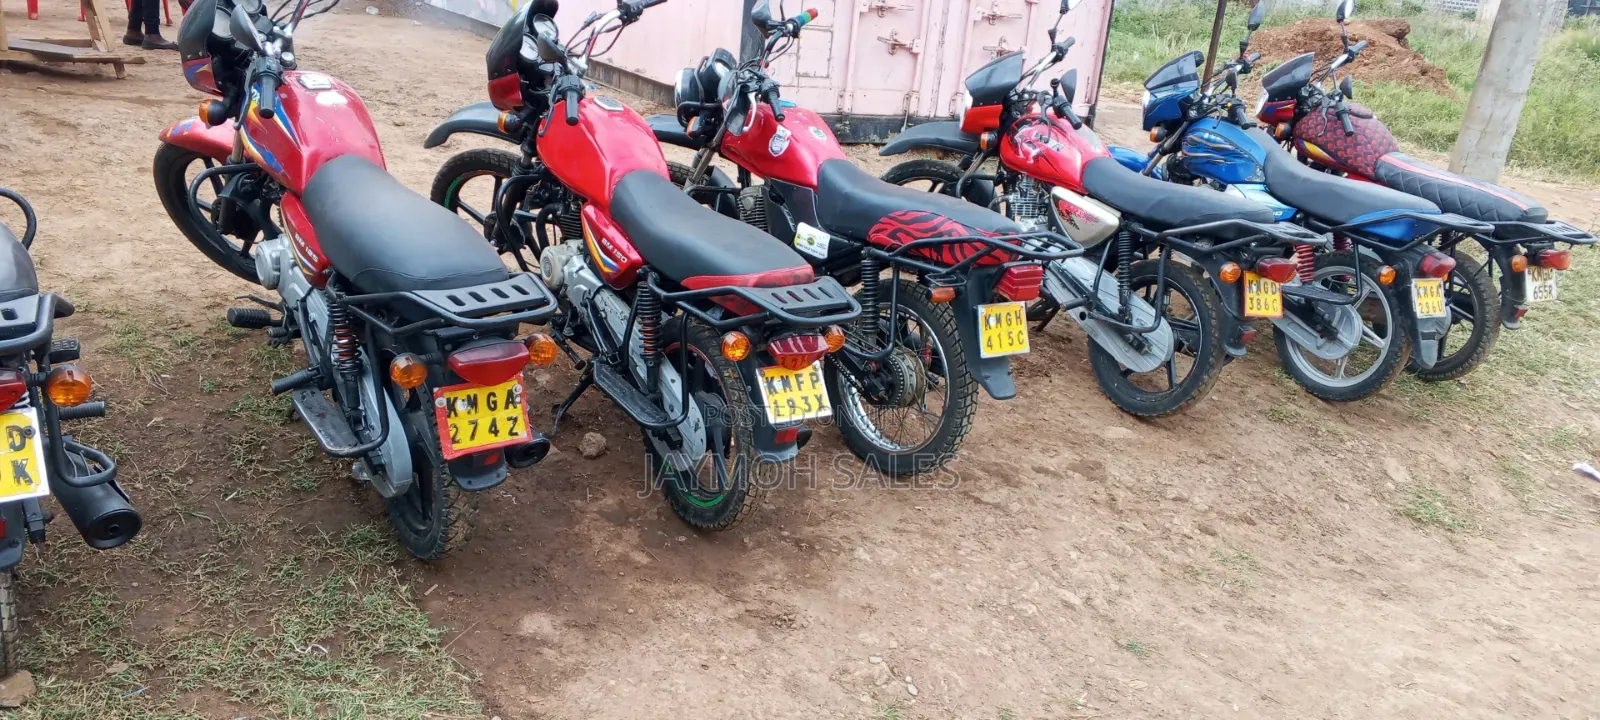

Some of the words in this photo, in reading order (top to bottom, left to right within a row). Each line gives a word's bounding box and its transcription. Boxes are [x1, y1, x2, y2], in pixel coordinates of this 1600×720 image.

[613, 248, 628, 264] 150
[1248, 279, 1277, 295] KMGD
[1533, 284, 1554, 300] 655R
[1249, 297, 1278, 312] 386C
[984, 309, 1023, 331] KMGH
[987, 330, 1024, 351] 415C
[765, 372, 821, 396] KMFP
[446, 388, 520, 418] KMGA
[773, 393, 826, 417] 193X
[449, 416, 519, 444] 274Z
[0, 458, 34, 486] K
